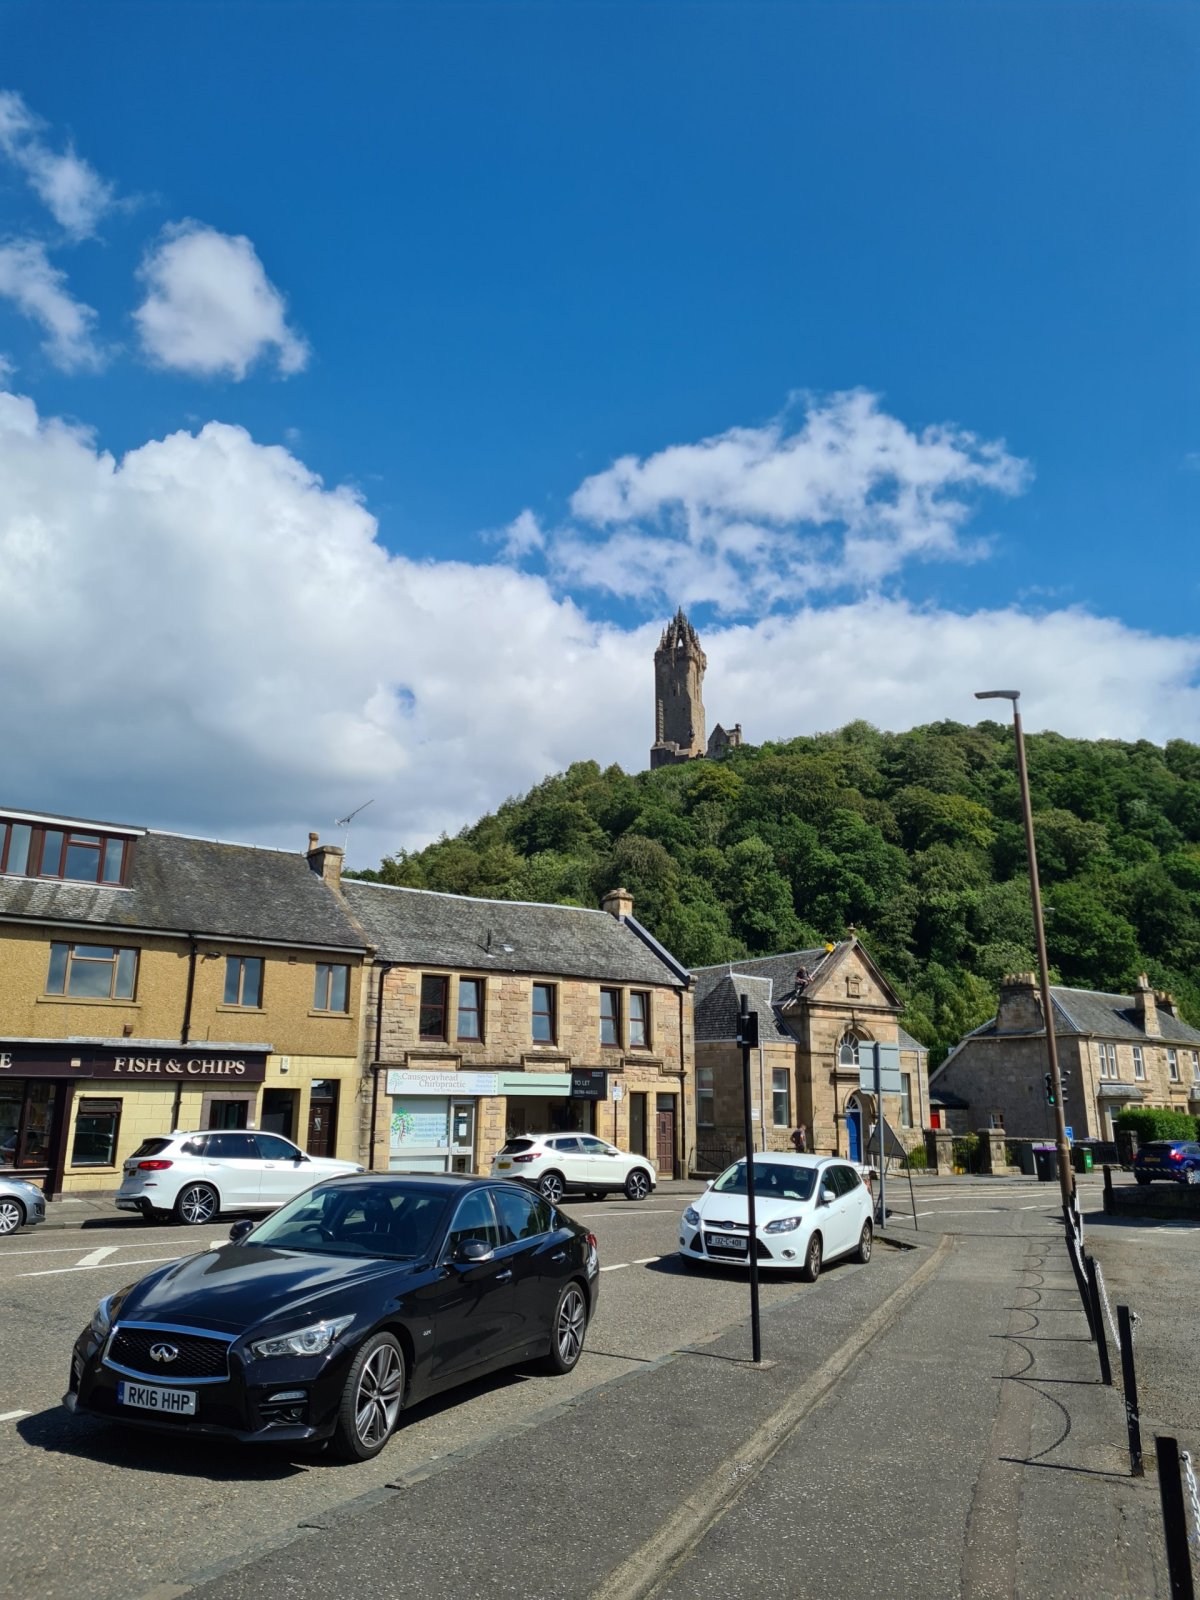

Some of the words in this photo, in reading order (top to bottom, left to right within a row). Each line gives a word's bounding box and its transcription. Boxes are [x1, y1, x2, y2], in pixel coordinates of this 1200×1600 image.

[113, 1057, 161, 1073] FISH
[165, 1058, 183, 1074] &
[187, 1058, 246, 1075] CHIPS
[401, 1072, 458, 1082] Causewayhead
[419, 1080, 466, 1088] Chiropractic
[128, 1386, 158, 1407] RK16
[162, 1392, 190, 1411] HHP
